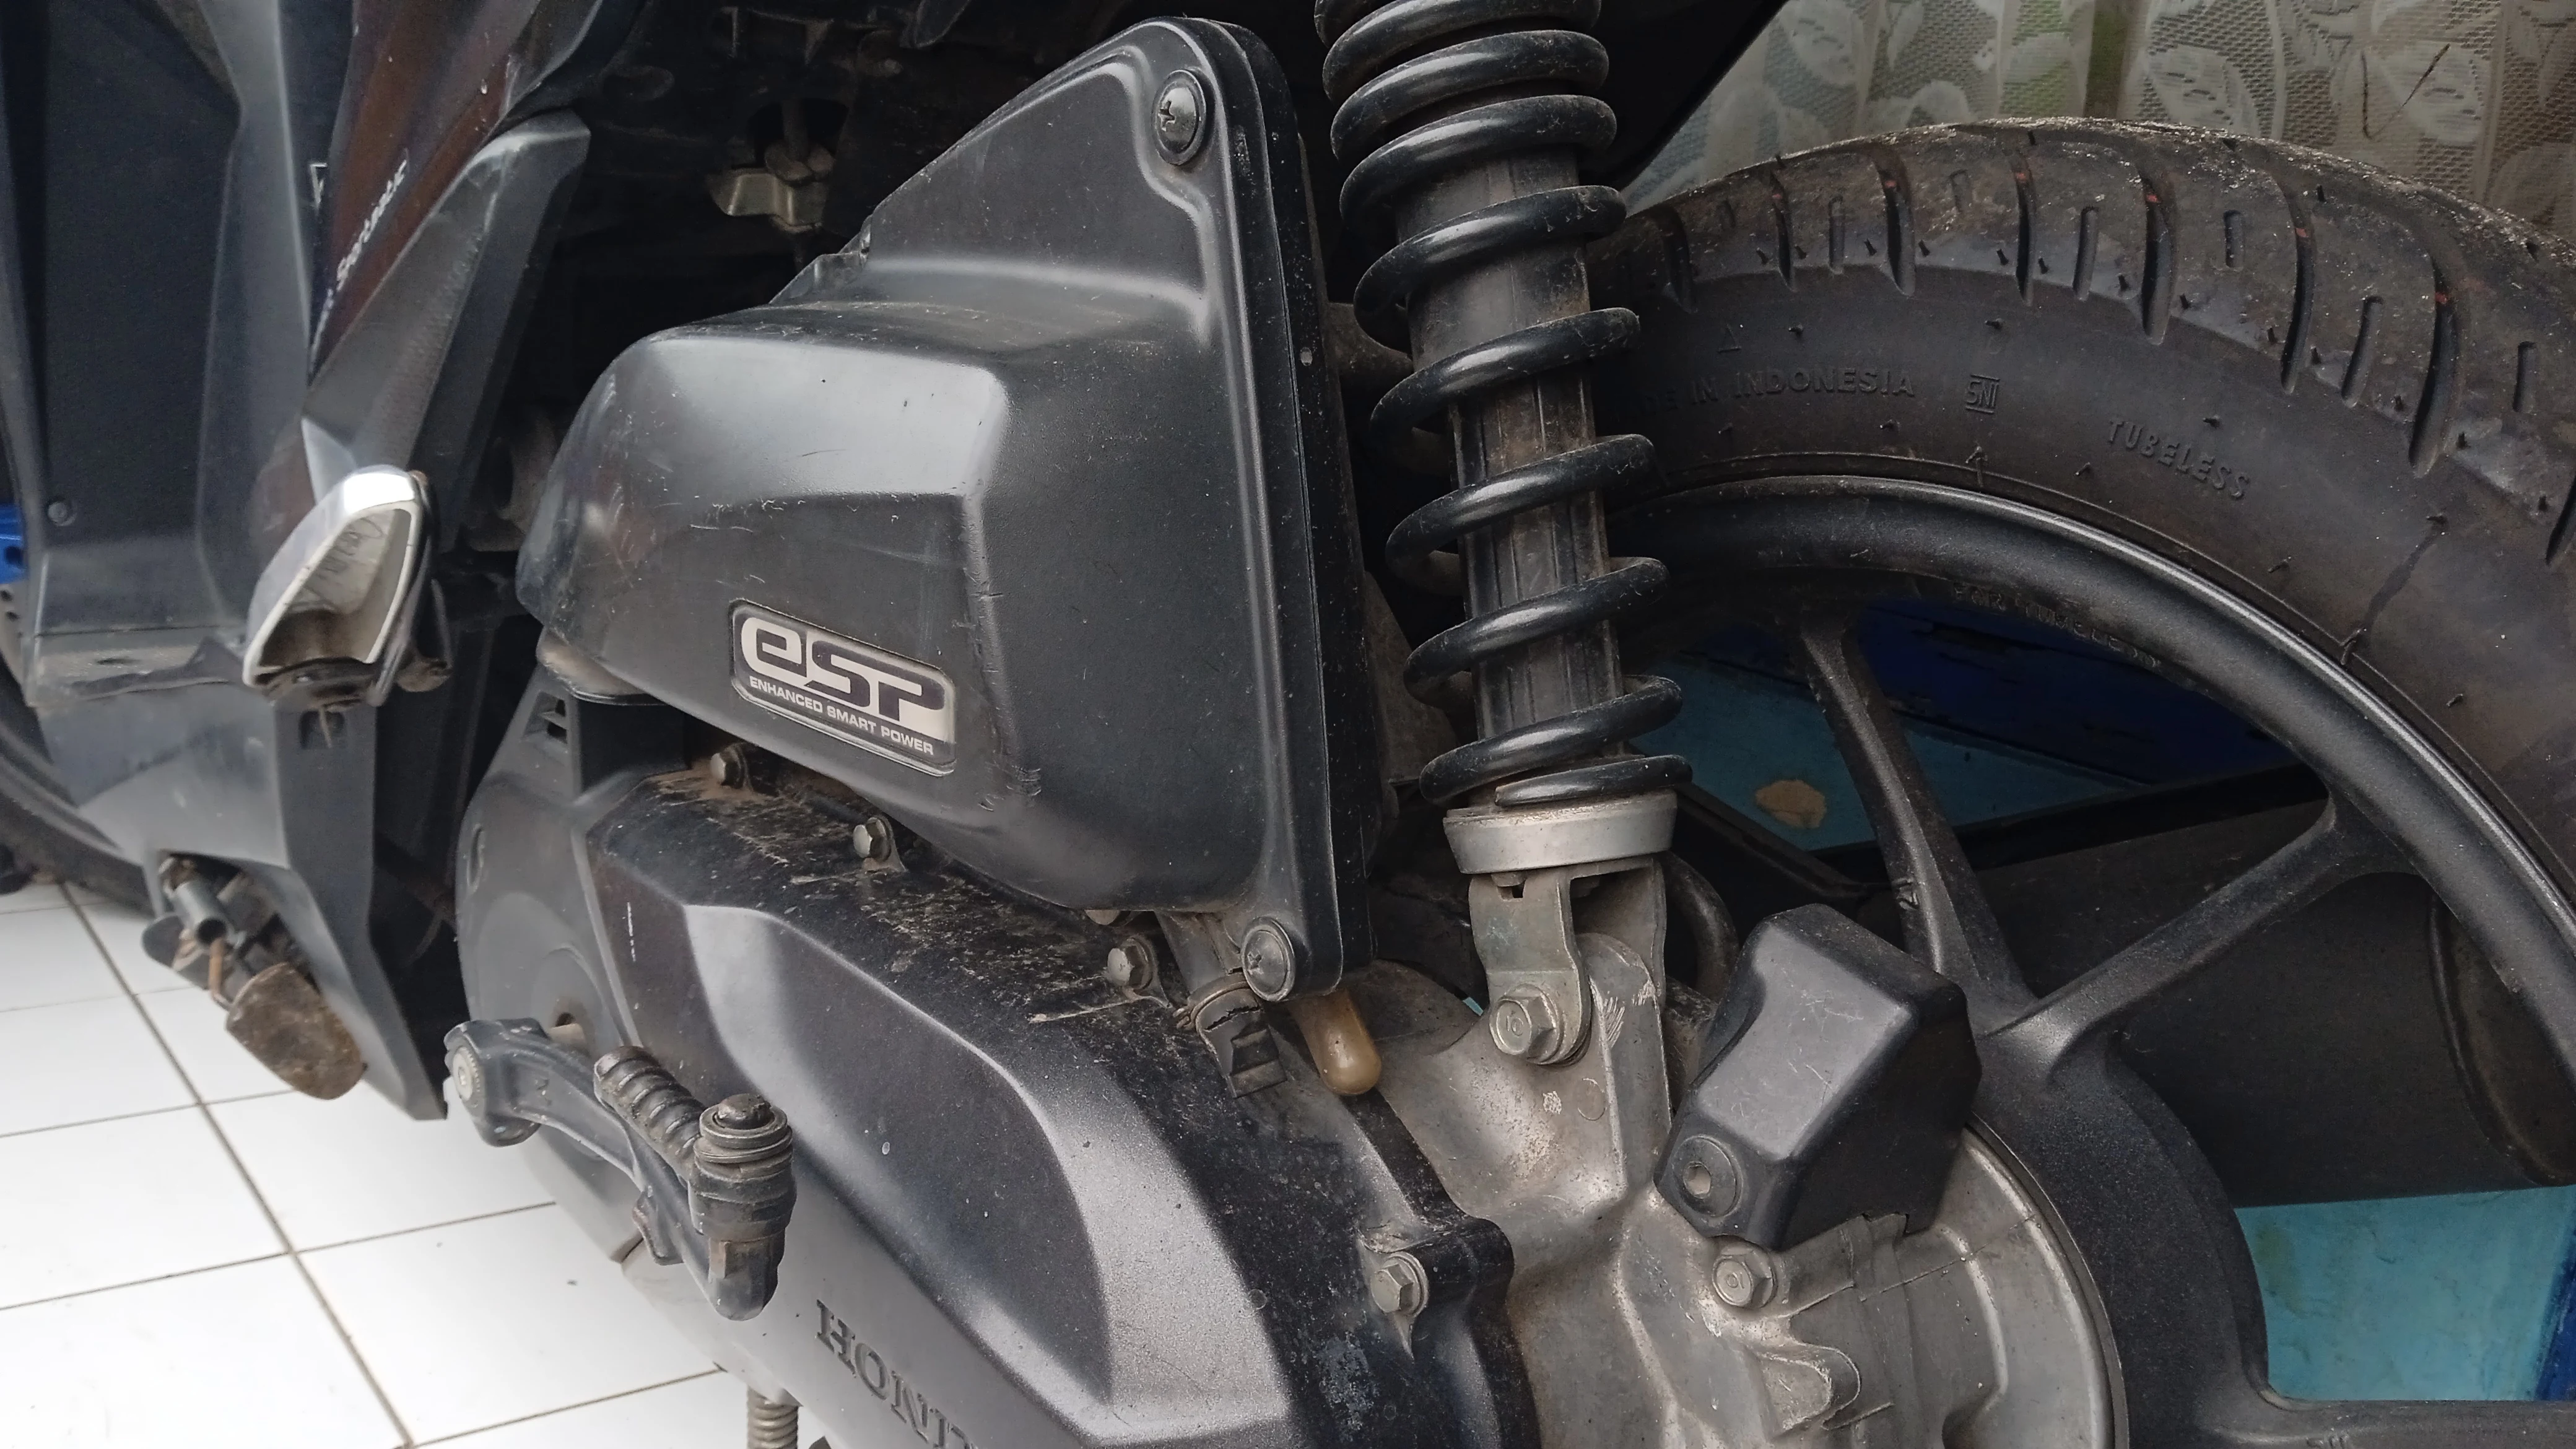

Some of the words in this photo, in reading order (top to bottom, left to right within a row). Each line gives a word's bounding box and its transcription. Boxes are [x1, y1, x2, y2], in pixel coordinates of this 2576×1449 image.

[1734, 367, 1915, 398] INDONESIA
[2108, 417, 2251, 500] TUBELESS
[749, 676, 823, 713] ENHANCED
[827, 705, 876, 737] SMART
[881, 726, 934, 755] POWER
